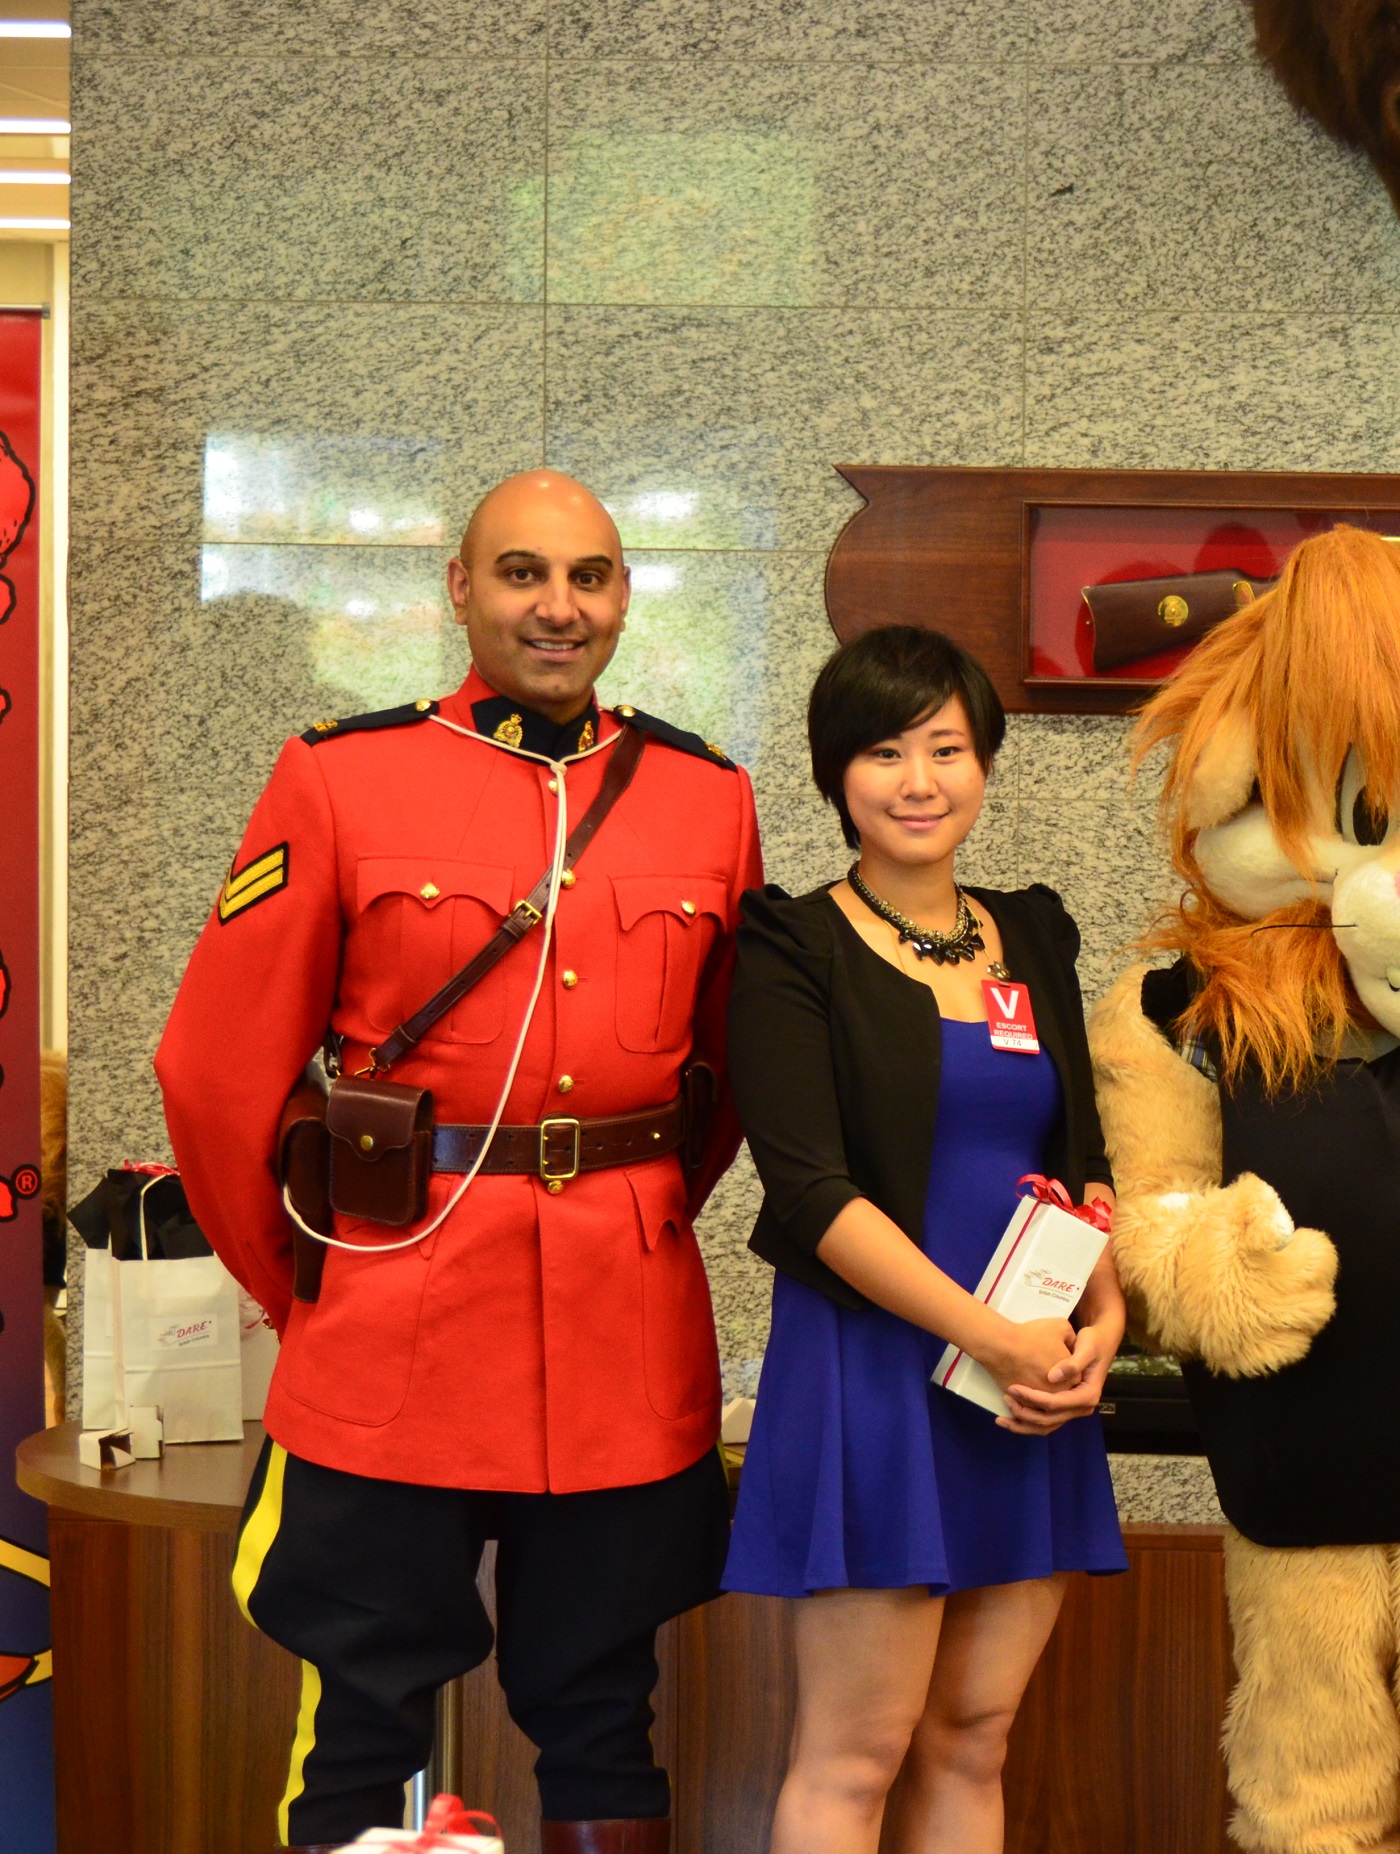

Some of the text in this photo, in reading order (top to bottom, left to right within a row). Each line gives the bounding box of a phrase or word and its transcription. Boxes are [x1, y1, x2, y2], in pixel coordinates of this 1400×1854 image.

[990, 987, 1020, 1019] V
[996, 1021, 1027, 1032] ESCORT
[993, 1029, 1033, 1040] REQUIRED
